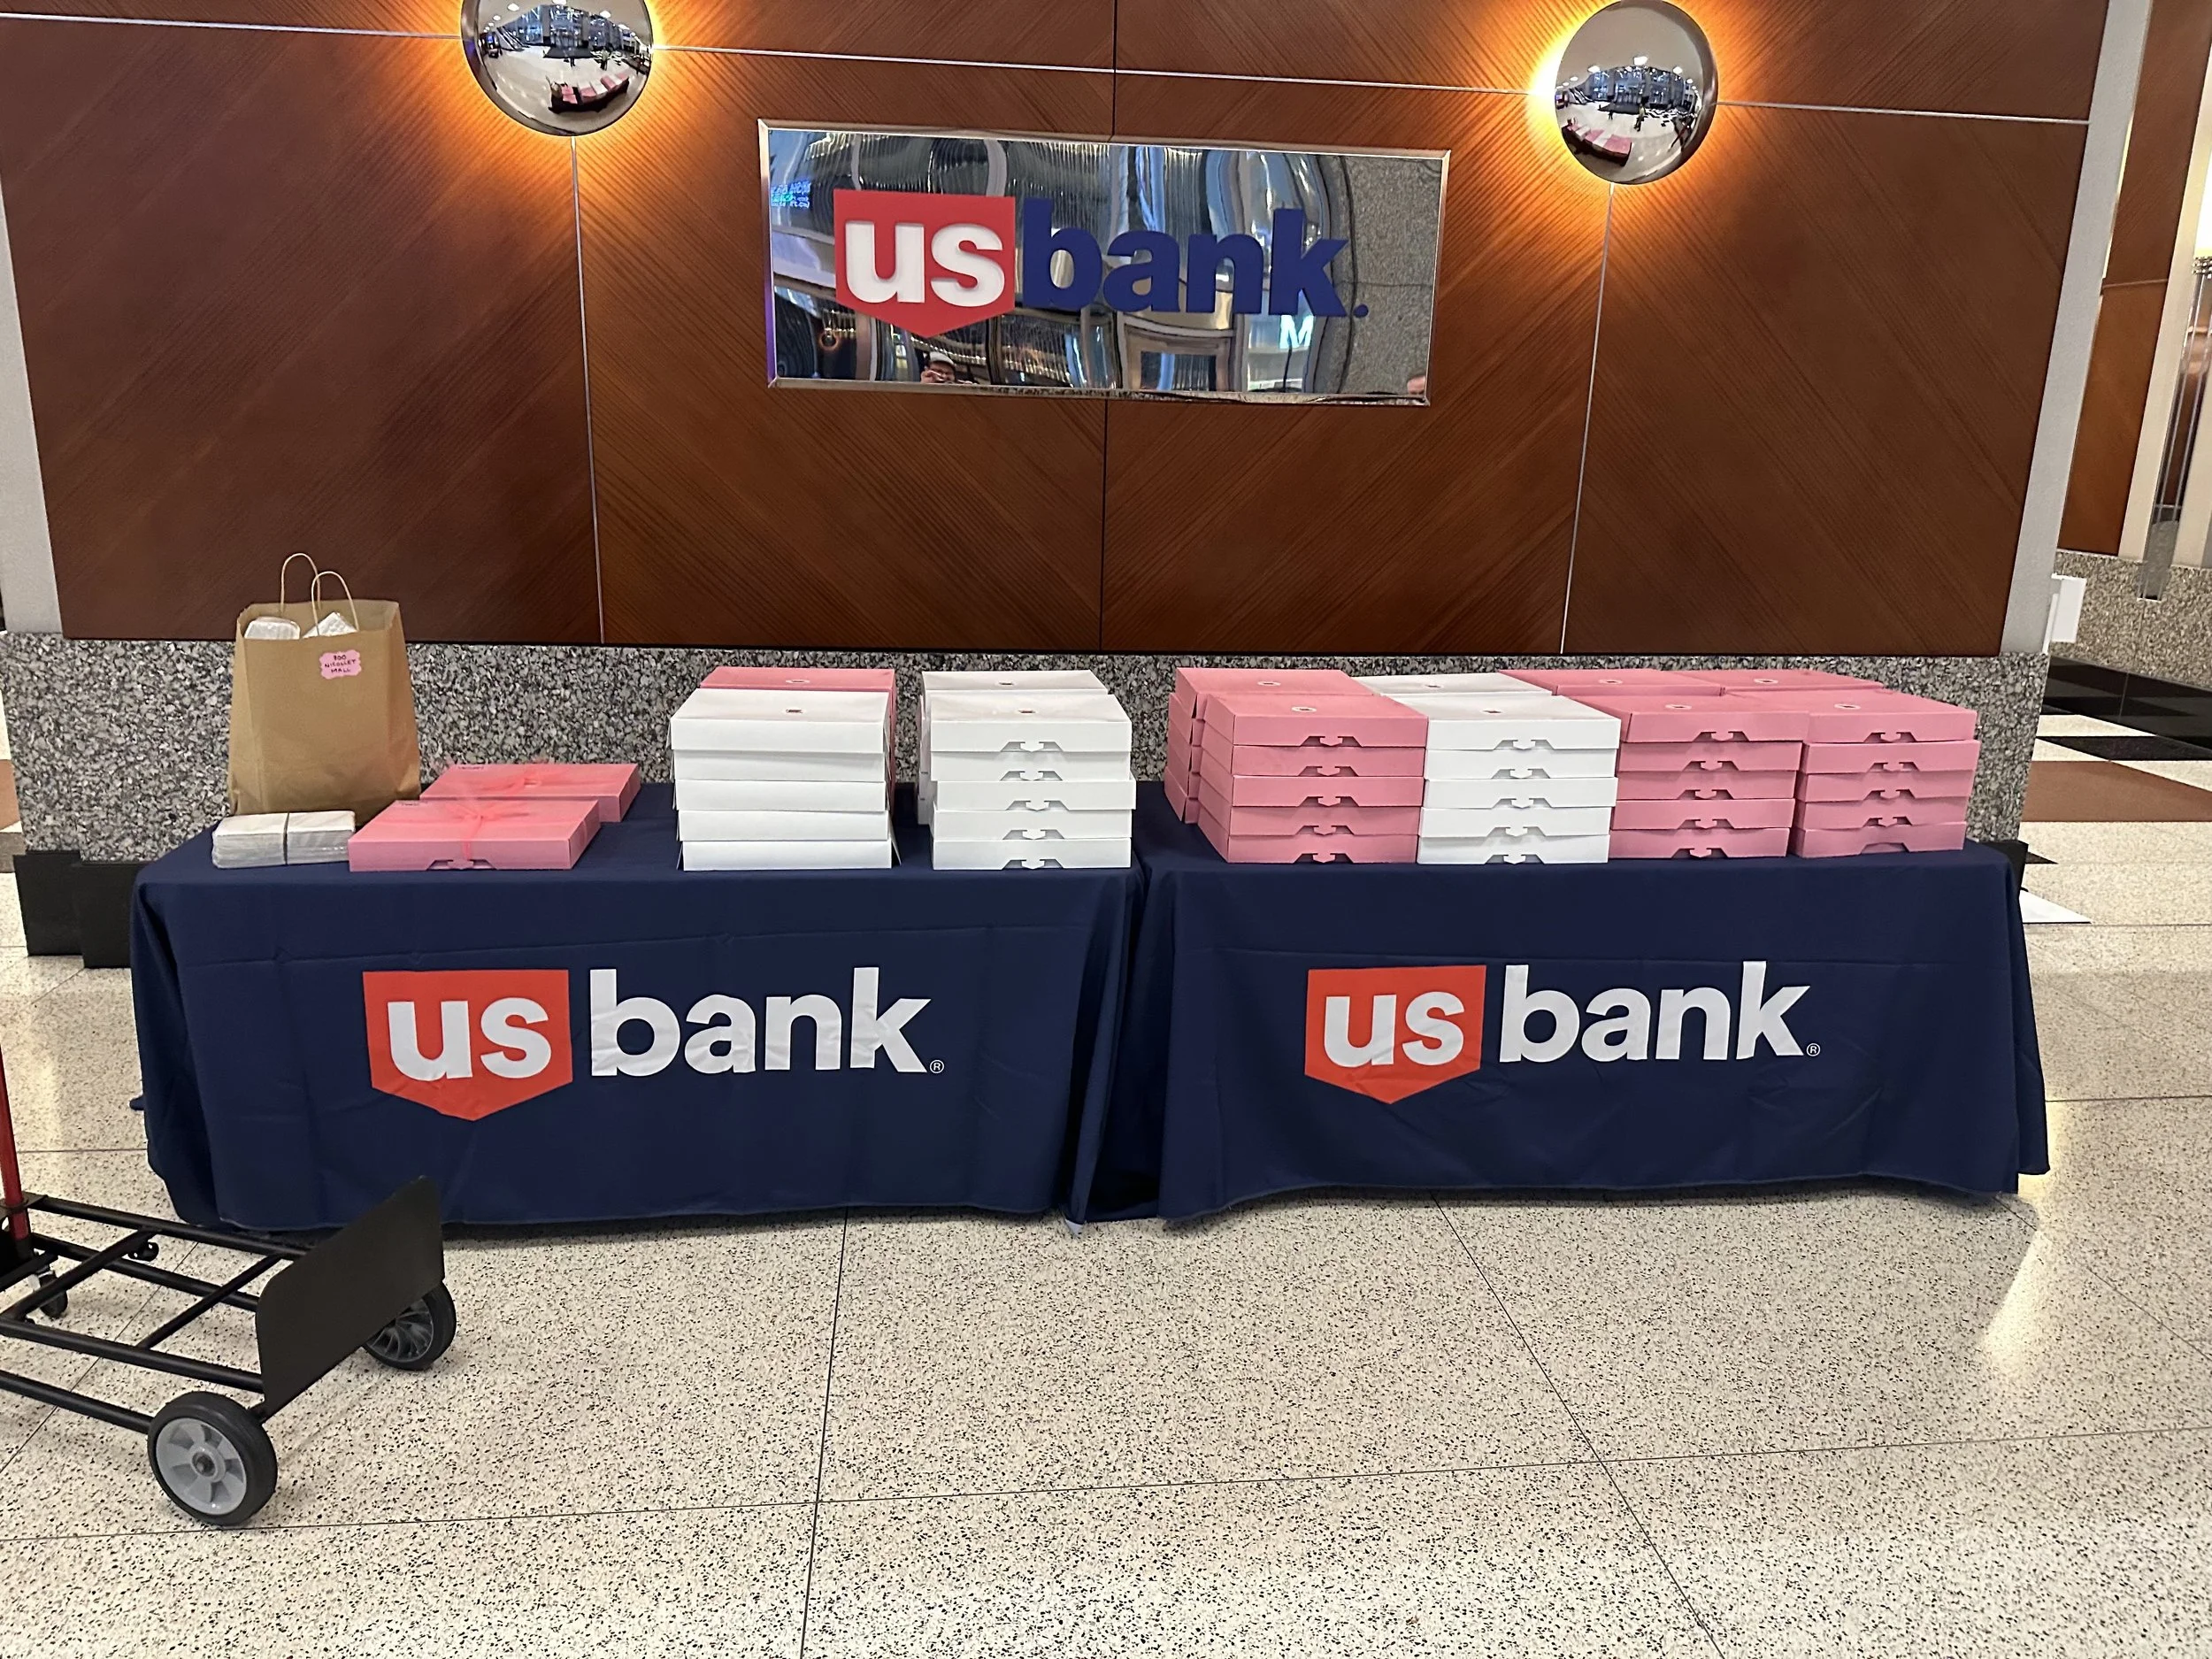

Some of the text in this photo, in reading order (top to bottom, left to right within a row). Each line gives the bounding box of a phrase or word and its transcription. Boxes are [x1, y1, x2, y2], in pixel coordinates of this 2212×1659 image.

[845, 221, 1005, 307] us
[388, 997, 551, 1081] us
[1324, 991, 1464, 1068] us
